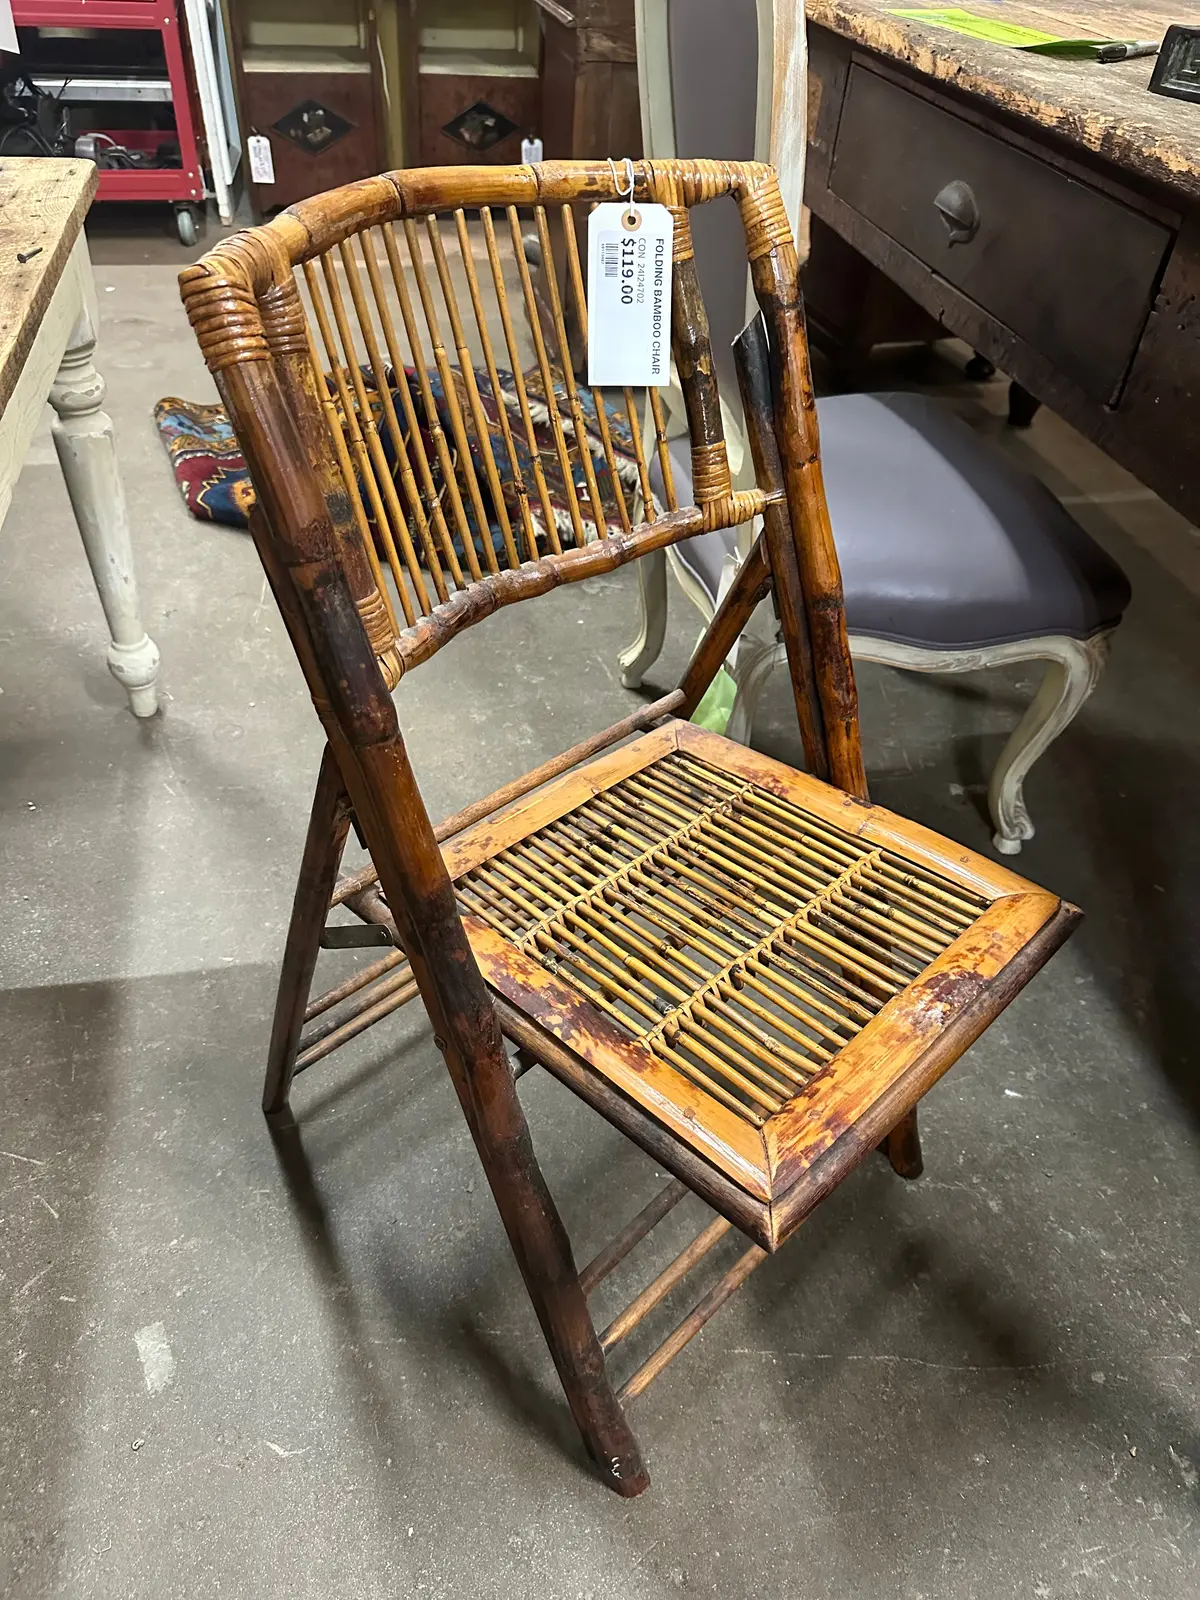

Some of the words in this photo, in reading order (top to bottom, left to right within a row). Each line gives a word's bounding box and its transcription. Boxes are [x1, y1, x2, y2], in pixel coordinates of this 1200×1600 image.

[620, 238, 637, 305] $119.00
[638, 237, 647, 259] CON
[653, 238, 665, 287] FOLDING
[652, 289, 663, 339] BAMBOO
[651, 341, 661, 375] CHAIR
